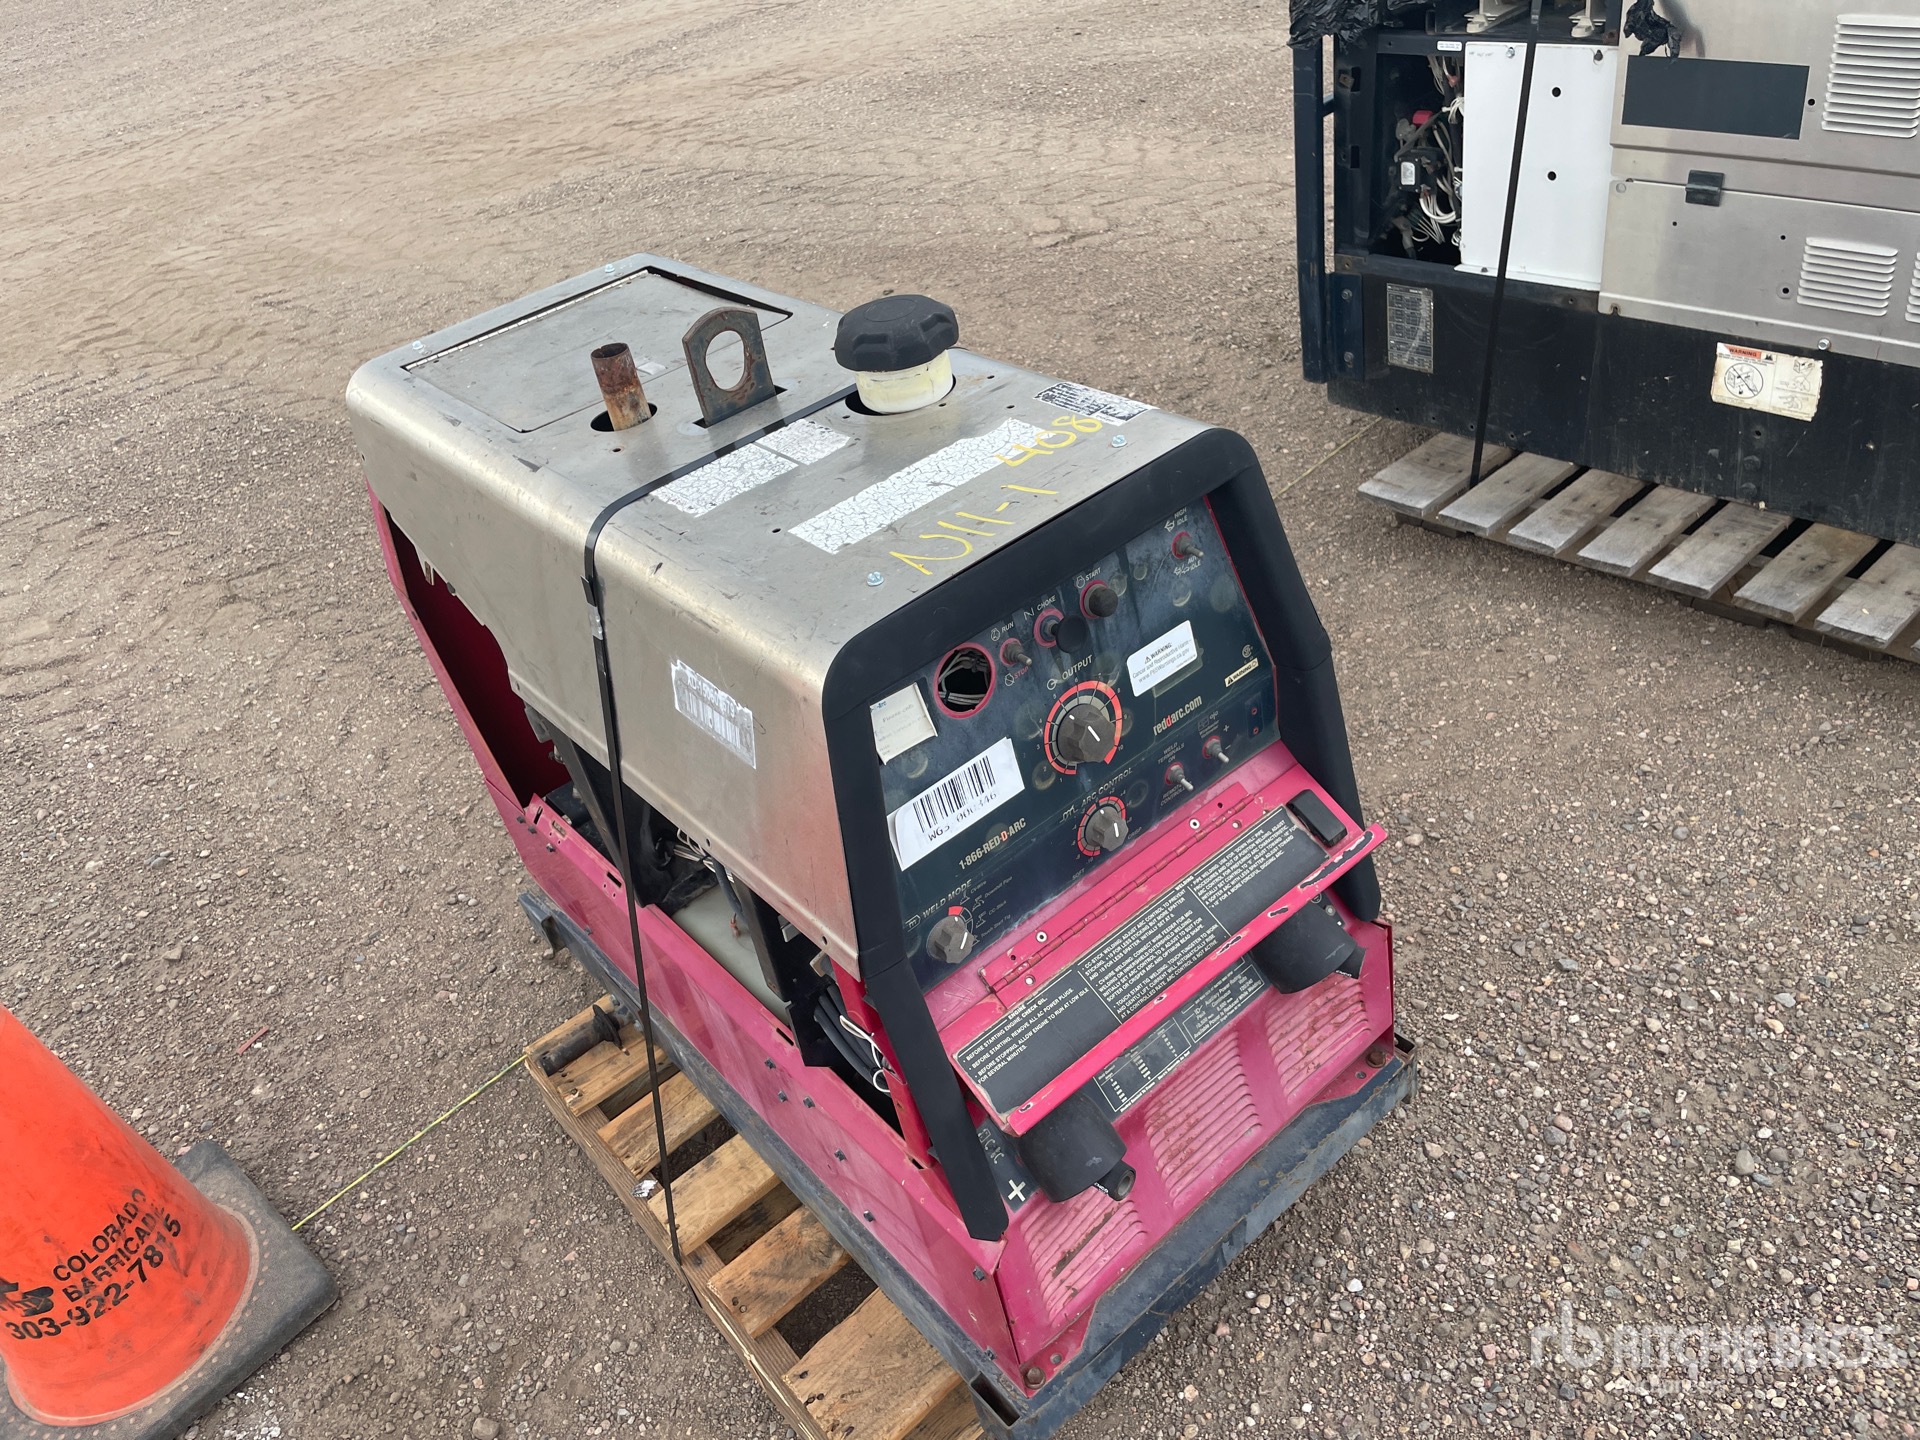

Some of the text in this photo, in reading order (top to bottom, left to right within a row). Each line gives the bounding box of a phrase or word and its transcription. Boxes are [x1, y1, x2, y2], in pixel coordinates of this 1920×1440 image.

[1729, 348, 1757, 357] WARNING
[1085, 567, 1101, 581] START
[1037, 595, 1056, 611] CHOKE
[1001, 621, 1014, 634] RUN
[1014, 666, 1029, 679] STOP
[1061, 655, 1093, 681] OUTPUT
[1232, 664, 1252, 680] WARNING
[1153, 695, 1203, 736] reddarc.com
[1158, 743, 1184, 764] TERMINALS
[1163, 742, 1178, 754] WELD
[1168, 755, 1176, 763] ON
[1081, 767, 1133, 807] ARC CONTROL
[958, 817, 1027, 869] 1-866-RED-D-ARC
[1175, 876, 1194, 891] WELDING
[922, 879, 972, 918] WELD MODE
[1219, 983, 1230, 993] Power
[1008, 1004, 1026, 1020] ENGINE
[966, 1045, 984, 1061] BEFORE
[983, 1029, 1005, 1047] STARTING
[1021, 1004, 1038, 1018] CHECK
[972, 1053, 990, 1068] BEFORE
[1011, 1022, 1029, 1037] REMOVE
[1029, 1016, 1038, 1024] ALL
[1044, 999, 1059, 1012] POWER
[978, 1060, 996, 1076] BEFORE
[1018, 1031, 1033, 1044] ALLOW
[1032, 1019, 1049, 1033] ENGINE
[1054, 1007, 1064, 1016] RUN
[1069, 995, 1080, 1004] LOW
[1079, 988, 1089, 997] IDLE
[978, 1074, 988, 1084] FOR
[987, 1059, 1007, 1076] SEVERAL
[53, 1188, 147, 1282] COLORADO
